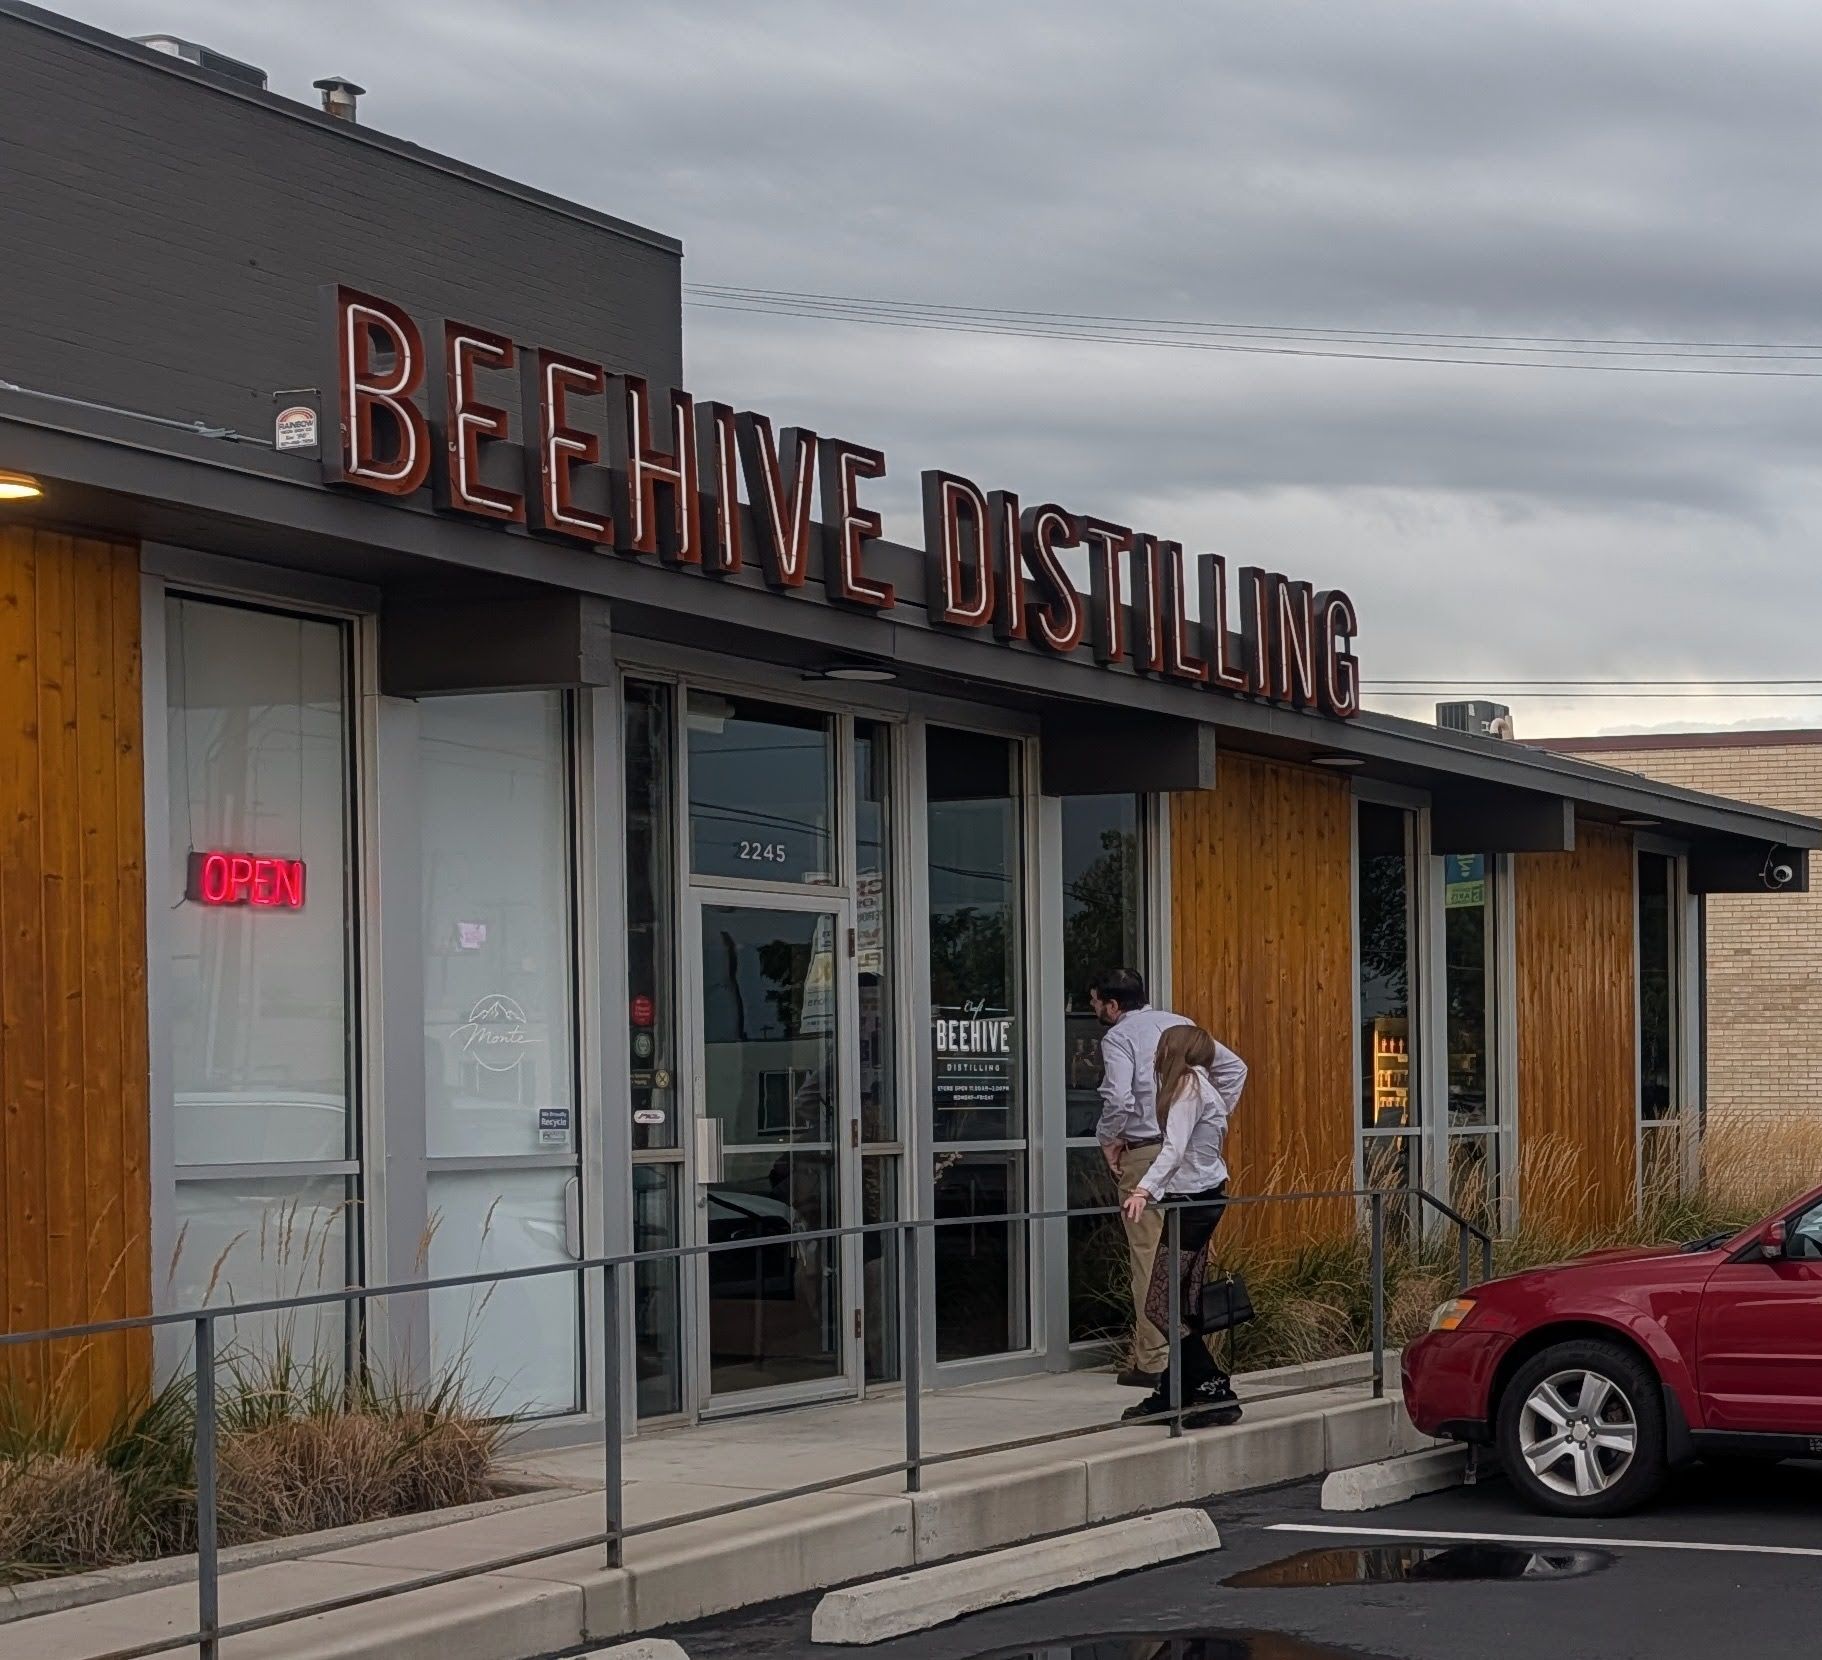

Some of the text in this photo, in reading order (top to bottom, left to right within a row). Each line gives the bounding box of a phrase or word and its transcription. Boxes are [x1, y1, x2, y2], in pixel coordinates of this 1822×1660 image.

[330, 283, 1360, 719] BEEHIVE DISTILLING
[740, 841, 786, 862] 2245
[203, 854, 302, 907] OPEN
[450, 1022, 546, 1051] Monte
[937, 1020, 1010, 1052] BEEHIVE
[946, 1063, 1000, 1072] DISTILLING
[541, 1117, 567, 1127] Recycle
